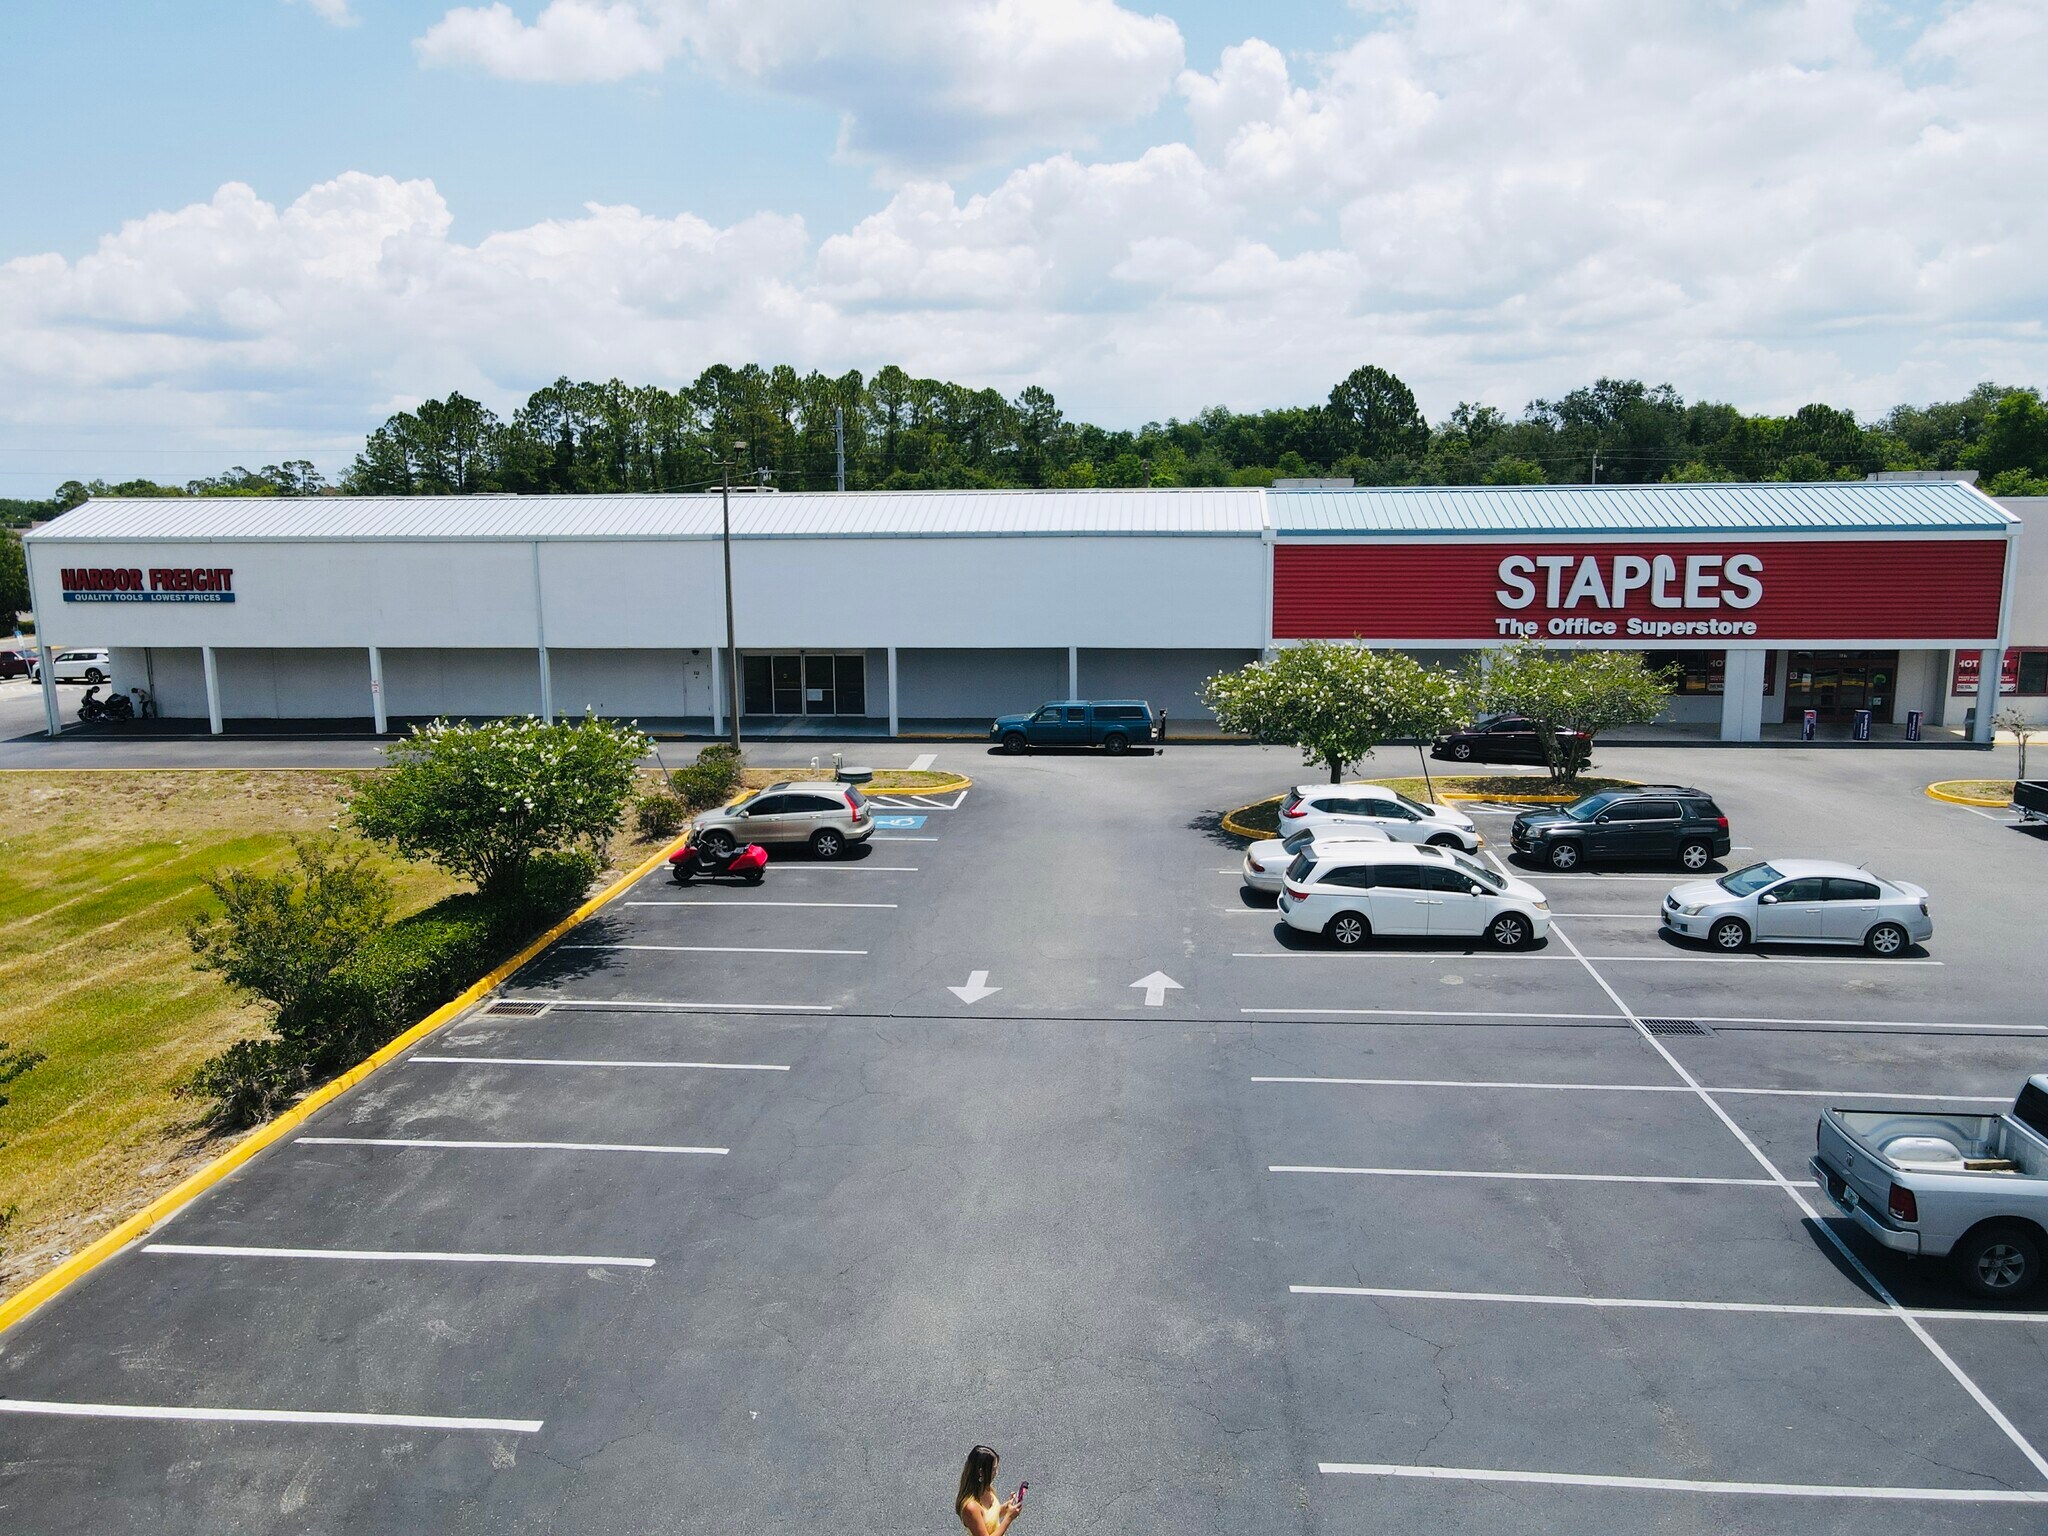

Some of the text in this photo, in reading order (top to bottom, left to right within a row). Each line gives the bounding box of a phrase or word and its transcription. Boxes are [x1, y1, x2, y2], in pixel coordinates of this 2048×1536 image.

[61, 568, 233, 591] HARBOR FREIGHT
[1495, 554, 1764, 610] STAPLES
[74, 593, 221, 602] QUALITY TOOLS LOWEST PRICES
[1495, 617, 1757, 638] The Office Superstore
